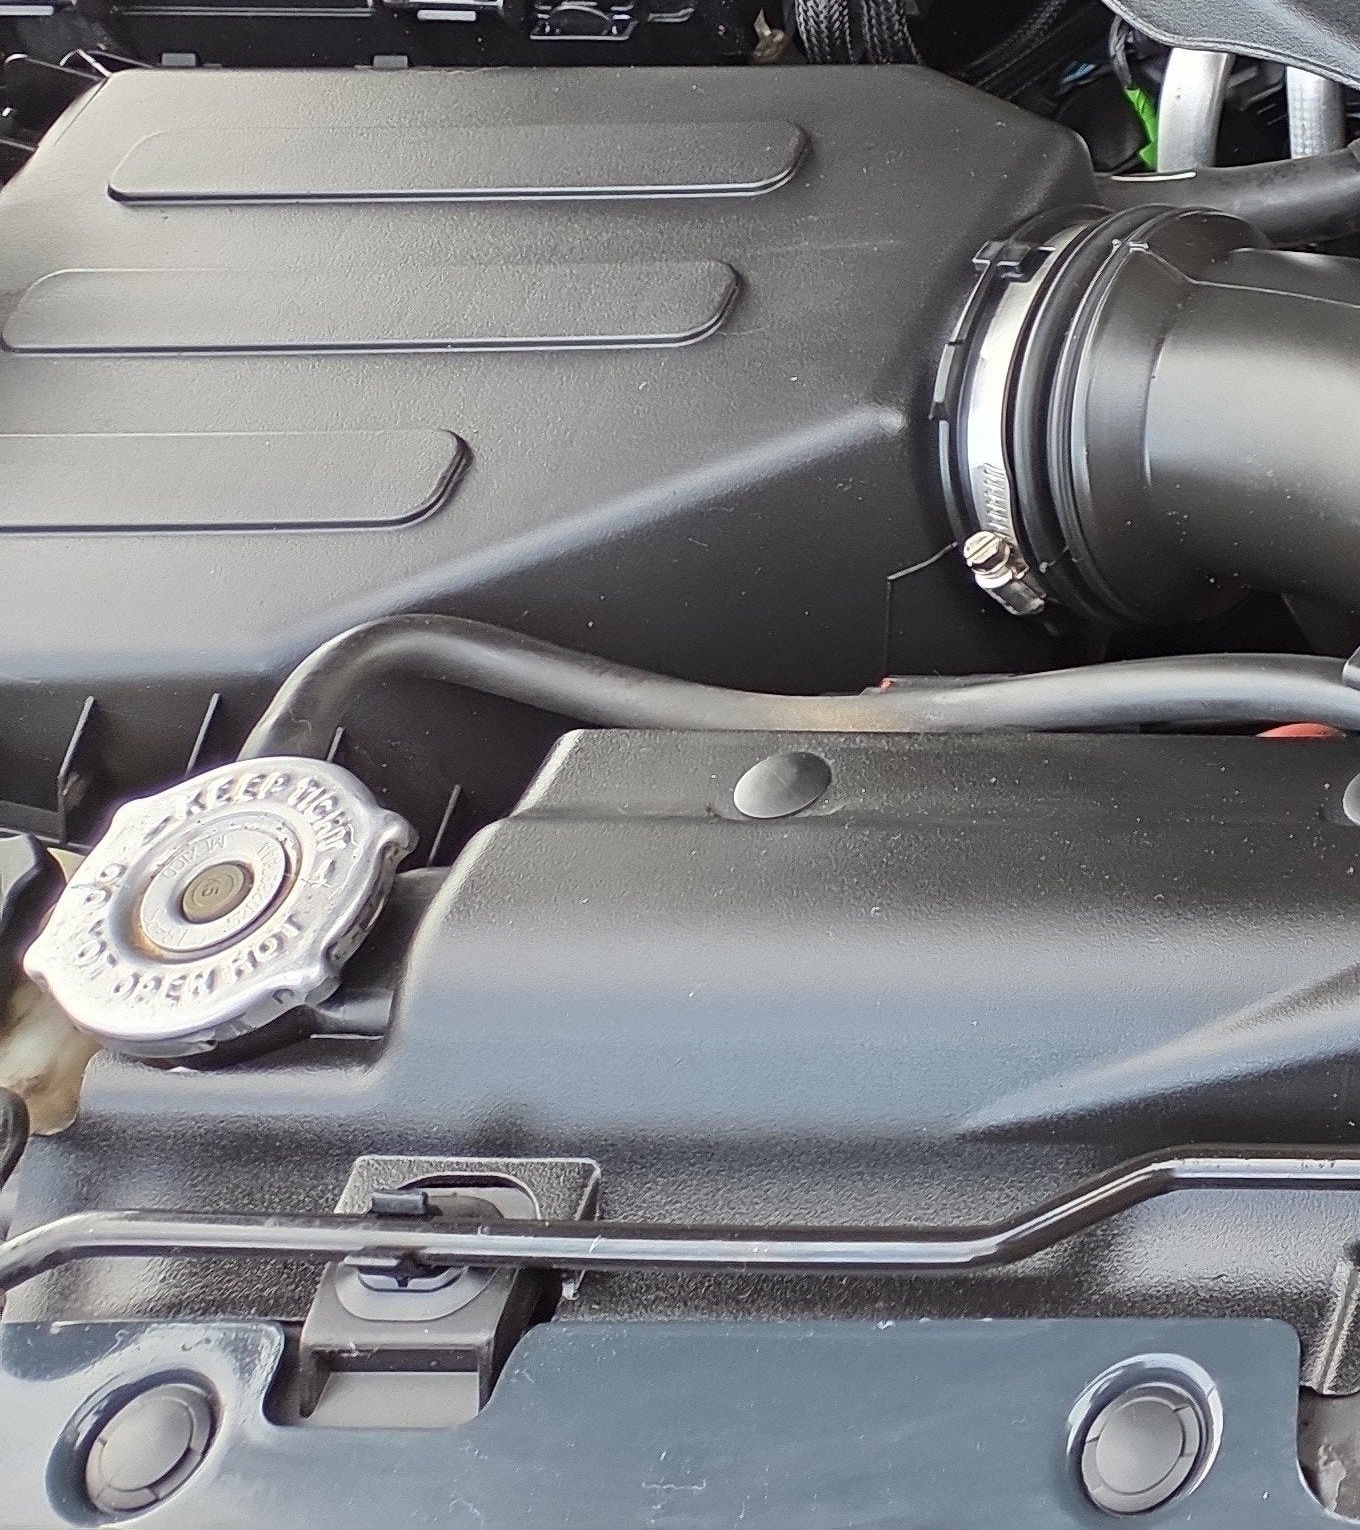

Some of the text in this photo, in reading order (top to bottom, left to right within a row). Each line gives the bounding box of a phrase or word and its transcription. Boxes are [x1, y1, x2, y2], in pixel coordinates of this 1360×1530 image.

[173, 771, 290, 824] KEEP
[111, 969, 216, 1008] OPEN
[231, 917, 304, 979] HOT
